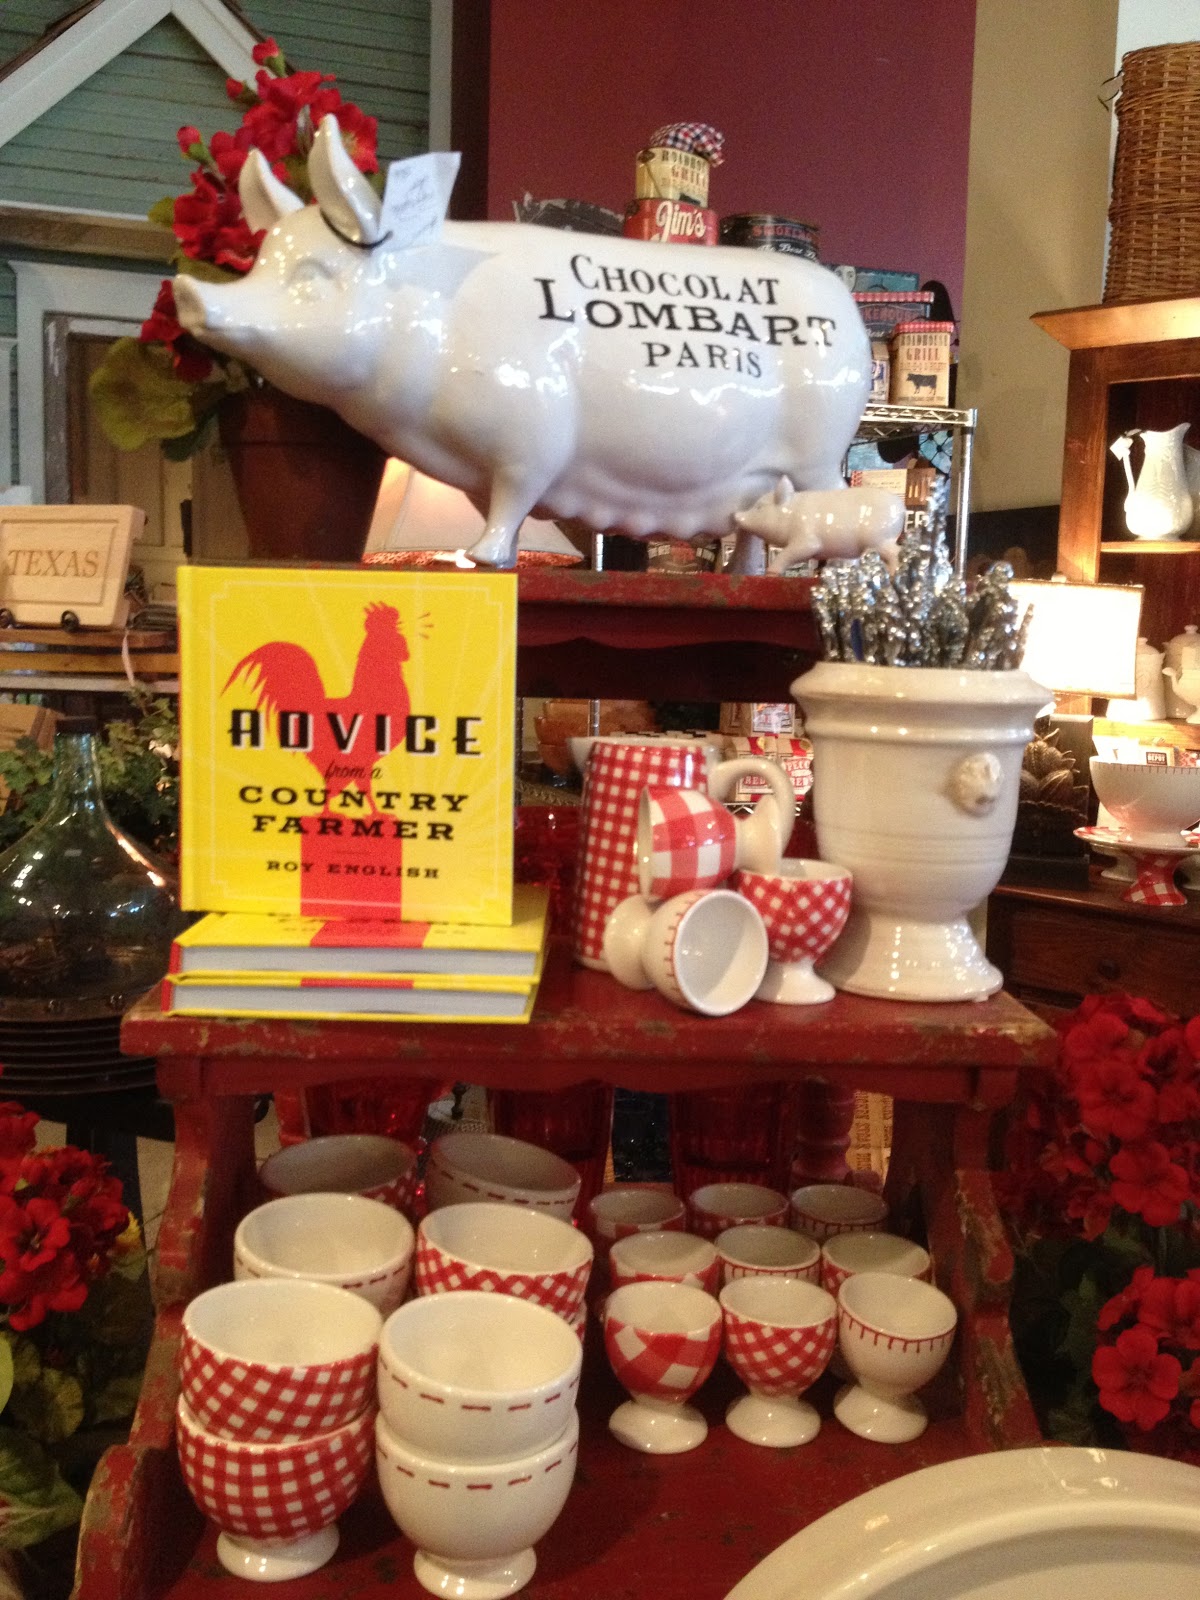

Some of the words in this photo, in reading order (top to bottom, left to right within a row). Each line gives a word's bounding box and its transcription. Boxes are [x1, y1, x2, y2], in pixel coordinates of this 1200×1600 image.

[656, 200, 706, 242] Jim's
[570, 254, 779, 305] CHOCOLAT
[534, 277, 836, 347] LOMBART
[642, 341, 763, 378] PARIS
[7, 549, 100, 578] TEXAS
[228, 709, 486, 758] ADVICE
[324, 761, 368, 784] from
[371, 766, 383, 780] a
[238, 785, 469, 813] COUNTRY
[252, 814, 455, 841] FARMER
[266, 860, 314, 874] ROY
[326, 863, 440, 880] ENGLISH
